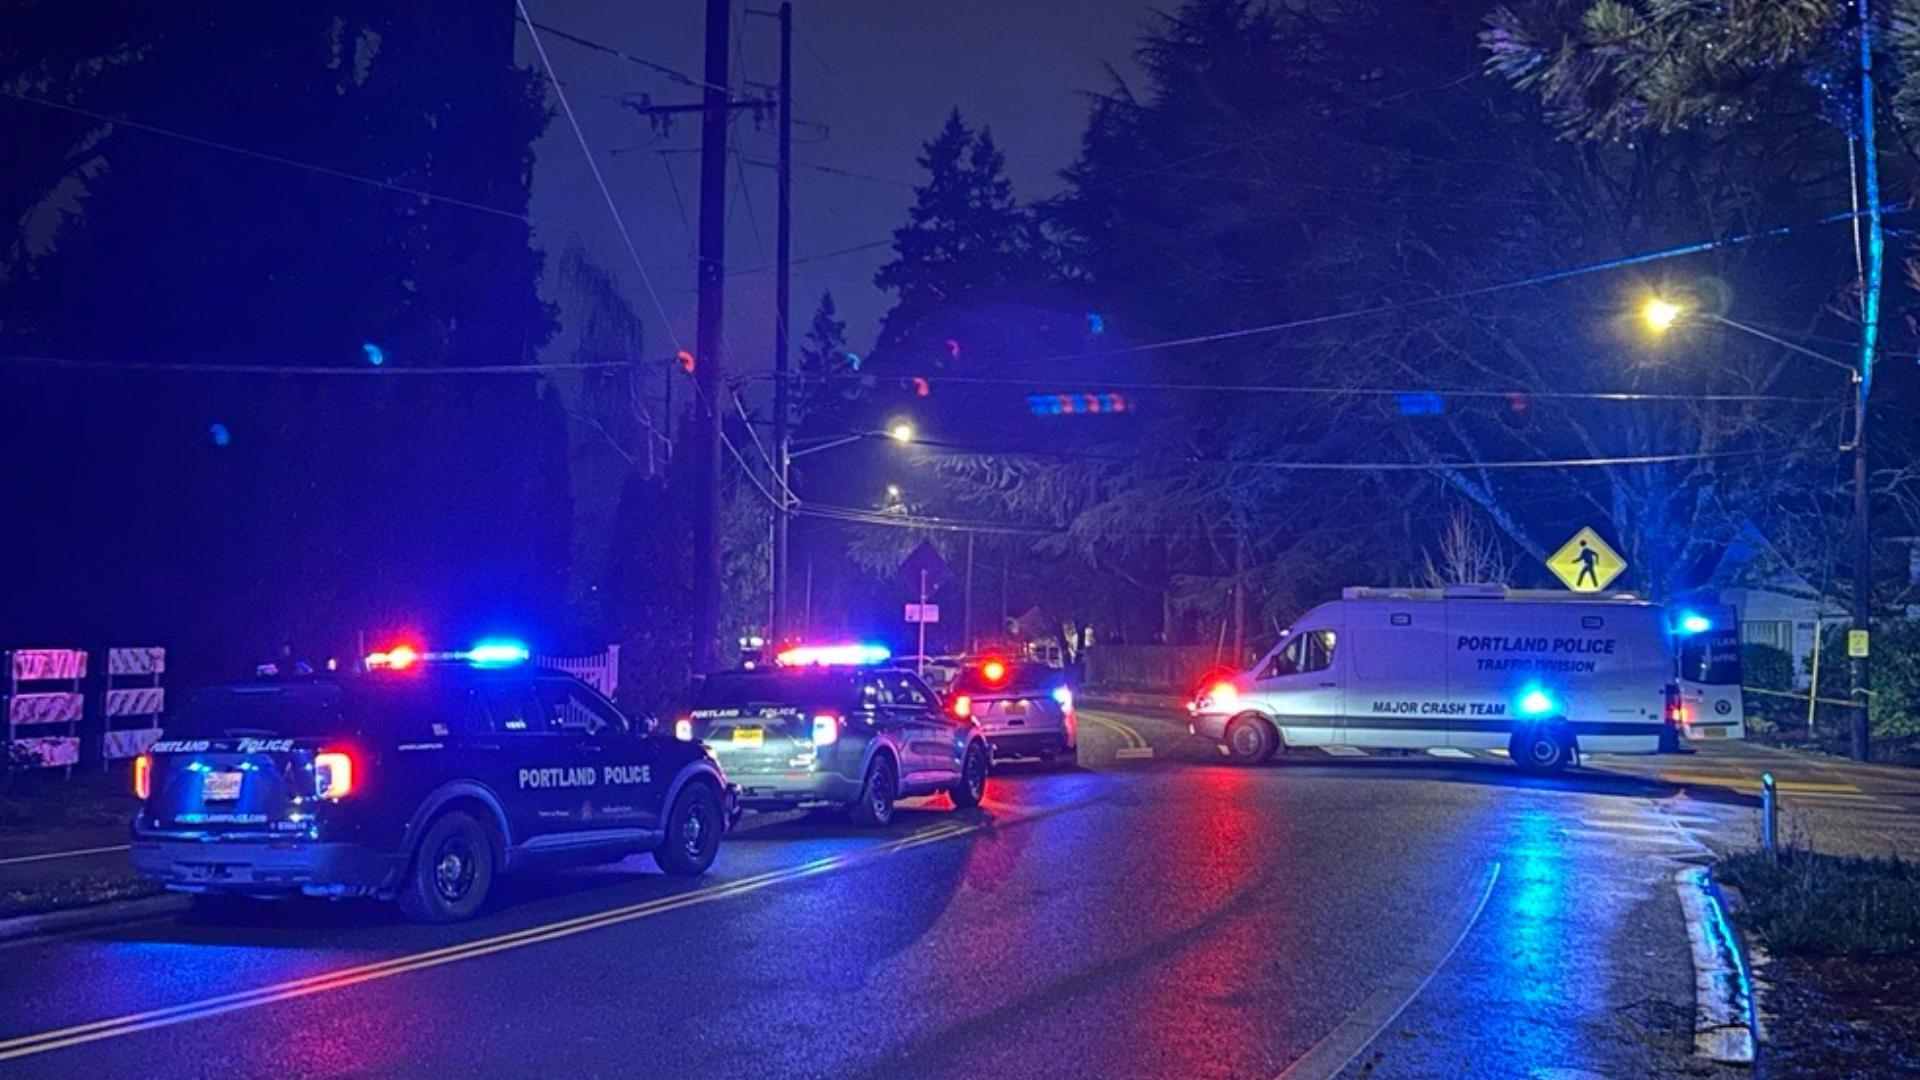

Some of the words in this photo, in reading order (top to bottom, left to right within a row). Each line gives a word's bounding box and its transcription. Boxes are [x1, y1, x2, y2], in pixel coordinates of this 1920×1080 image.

[1457, 636, 1548, 653] PORTLAND
[1553, 637, 1615, 654] POLICE
[1477, 658, 1533, 672] TRAFFIC
[1534, 659, 1596, 673] DIVISION
[690, 709, 740, 718] PORTLAND
[759, 708, 797, 718] POLICE
[1372, 701, 1418, 714] MAJOR
[1421, 702, 1466, 715] CRASH
[1470, 703, 1505, 715] TEAM
[149, 740, 210, 752] PORTLAND
[236, 738, 294, 752] POLICE
[519, 768, 596, 789] PORTLAND
[604, 765, 651, 785] POLICE
